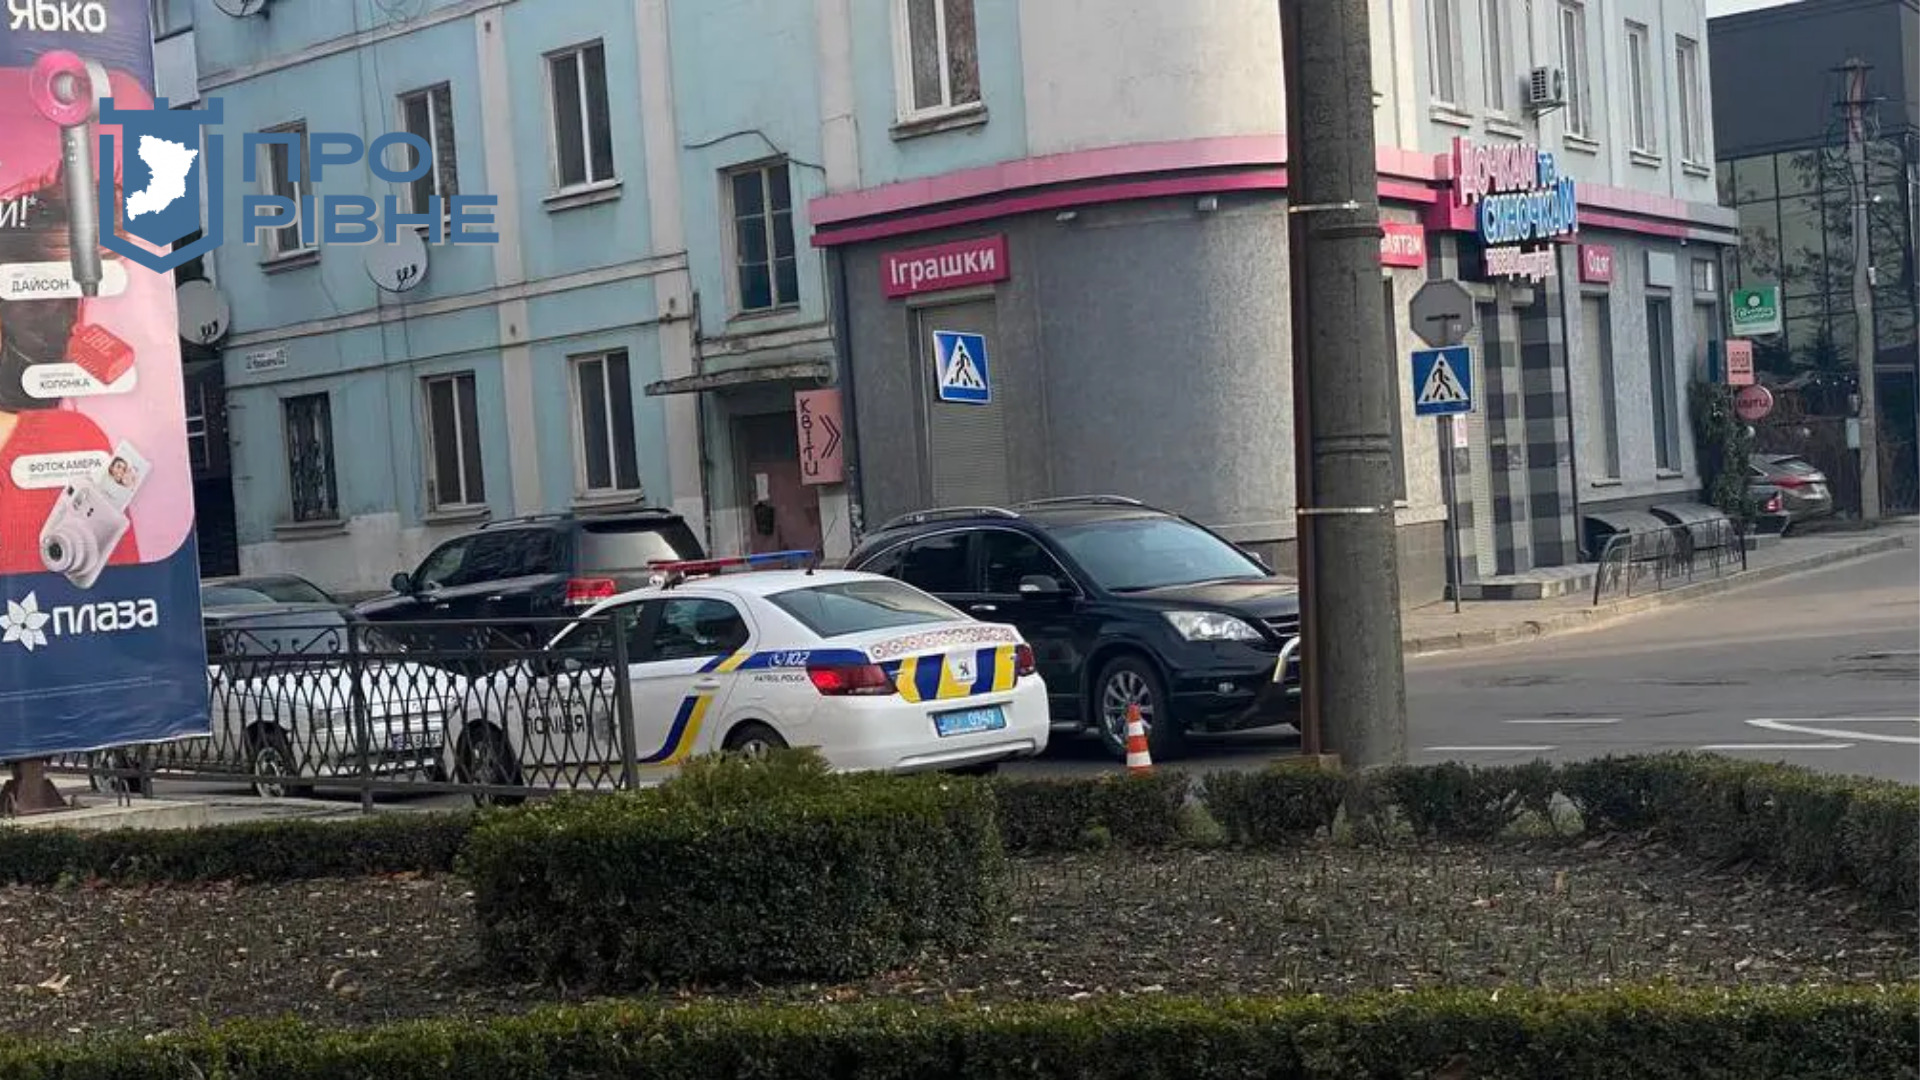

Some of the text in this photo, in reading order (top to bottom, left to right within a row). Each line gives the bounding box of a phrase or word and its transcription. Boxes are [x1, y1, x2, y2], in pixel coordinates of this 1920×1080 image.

[890, 248, 996, 289] Іграшки
[11, 277, 70, 294] ДАЙСОН
[29, 457, 102, 472] ФОТОКАМЕРА
[53, 598, 159, 635] плаза
[785, 653, 809, 666] 102
